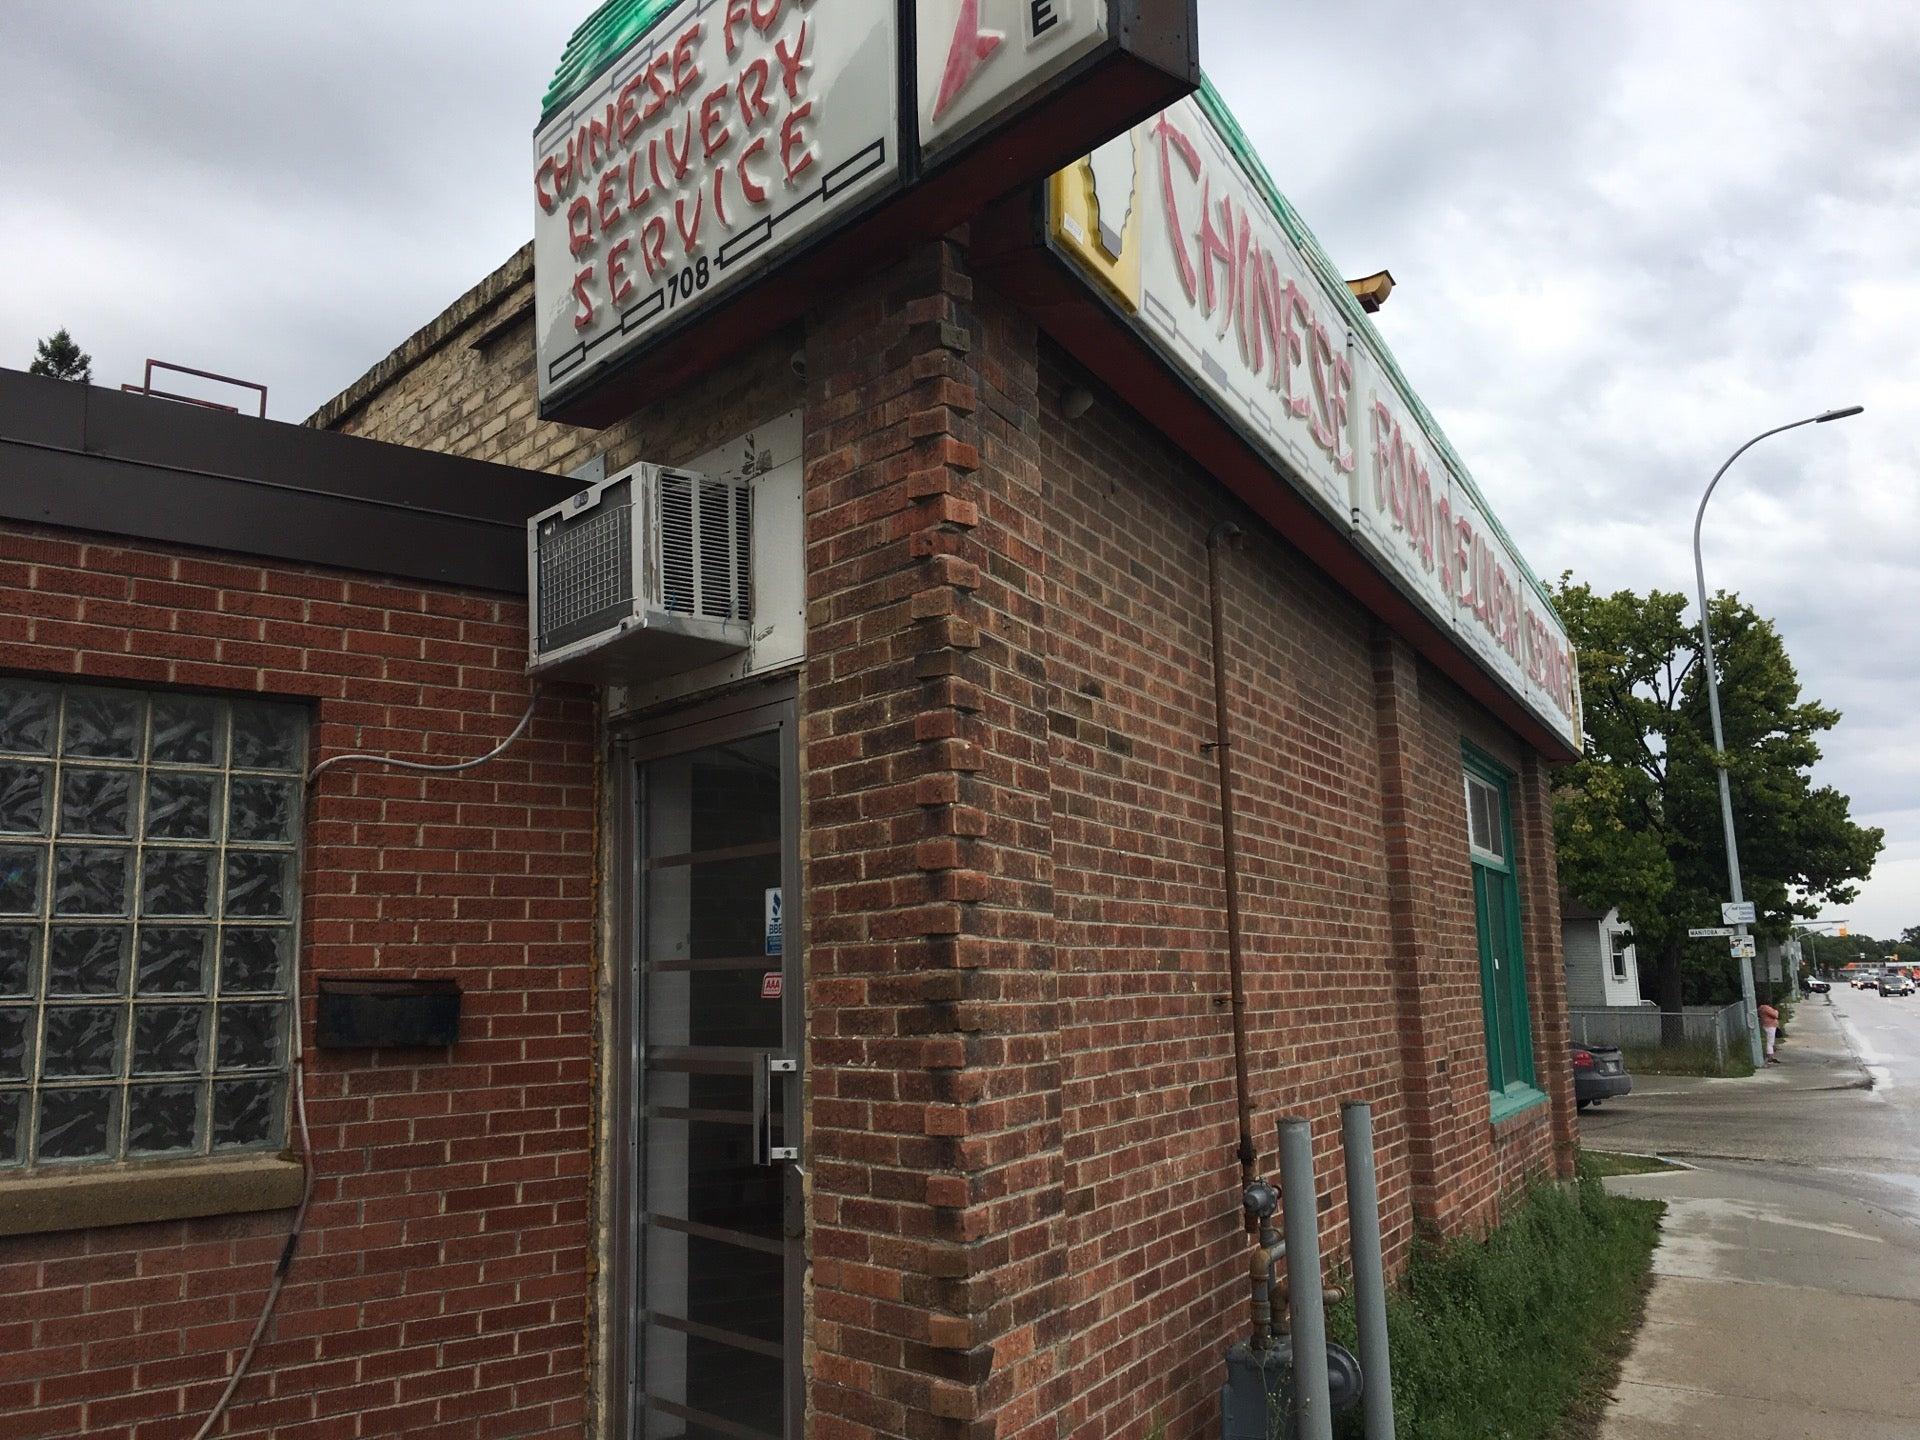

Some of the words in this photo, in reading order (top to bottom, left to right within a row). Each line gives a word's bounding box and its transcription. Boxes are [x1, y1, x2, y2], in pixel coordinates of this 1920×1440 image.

[534, 22, 702, 214] CHINESE
[567, 20, 807, 257] DELIVERY
[572, 101, 815, 332] SERVICE
[667, 256, 710, 309] 708
[1151, 109, 1355, 473] CHINESE
